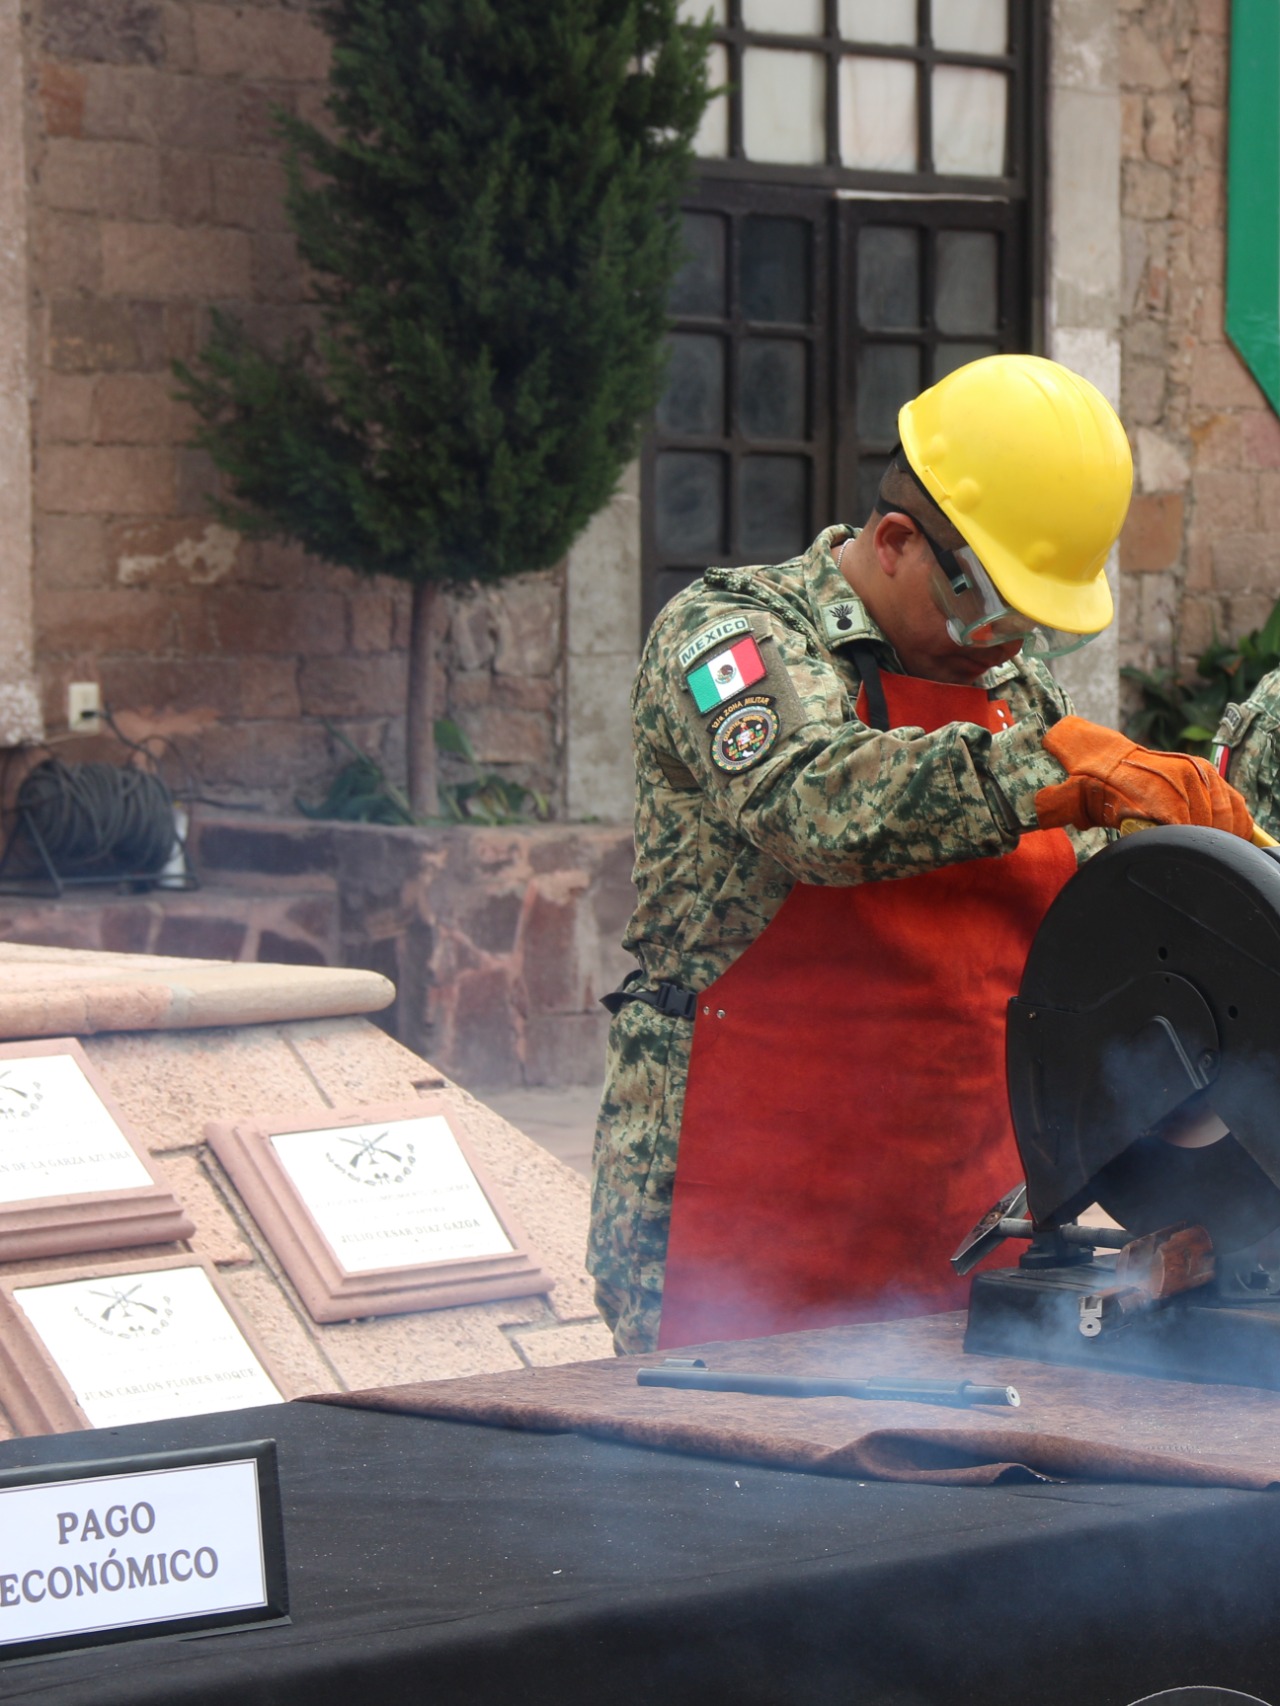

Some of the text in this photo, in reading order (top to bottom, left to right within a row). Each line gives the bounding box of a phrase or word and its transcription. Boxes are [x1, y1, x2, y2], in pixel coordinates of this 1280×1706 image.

[681, 620, 746, 664] MEXICO
[723, 701, 743, 717] ZONA
[744, 696, 770, 706] MILITAR
[48, 1156, 86, 1168] GARZA
[340, 1231, 374, 1243] JULIO
[375, 1227, 413, 1239] CESAR
[414, 1224, 441, 1235] DIAZ
[84, 1389, 114, 1401] JUAN
[115, 1381, 163, 1396] CARLOS
[164, 1374, 213, 1389] FLORES
[57, 1501, 156, 1545] PAGO
[0, 1546, 219, 1607] ECONÓMICO
